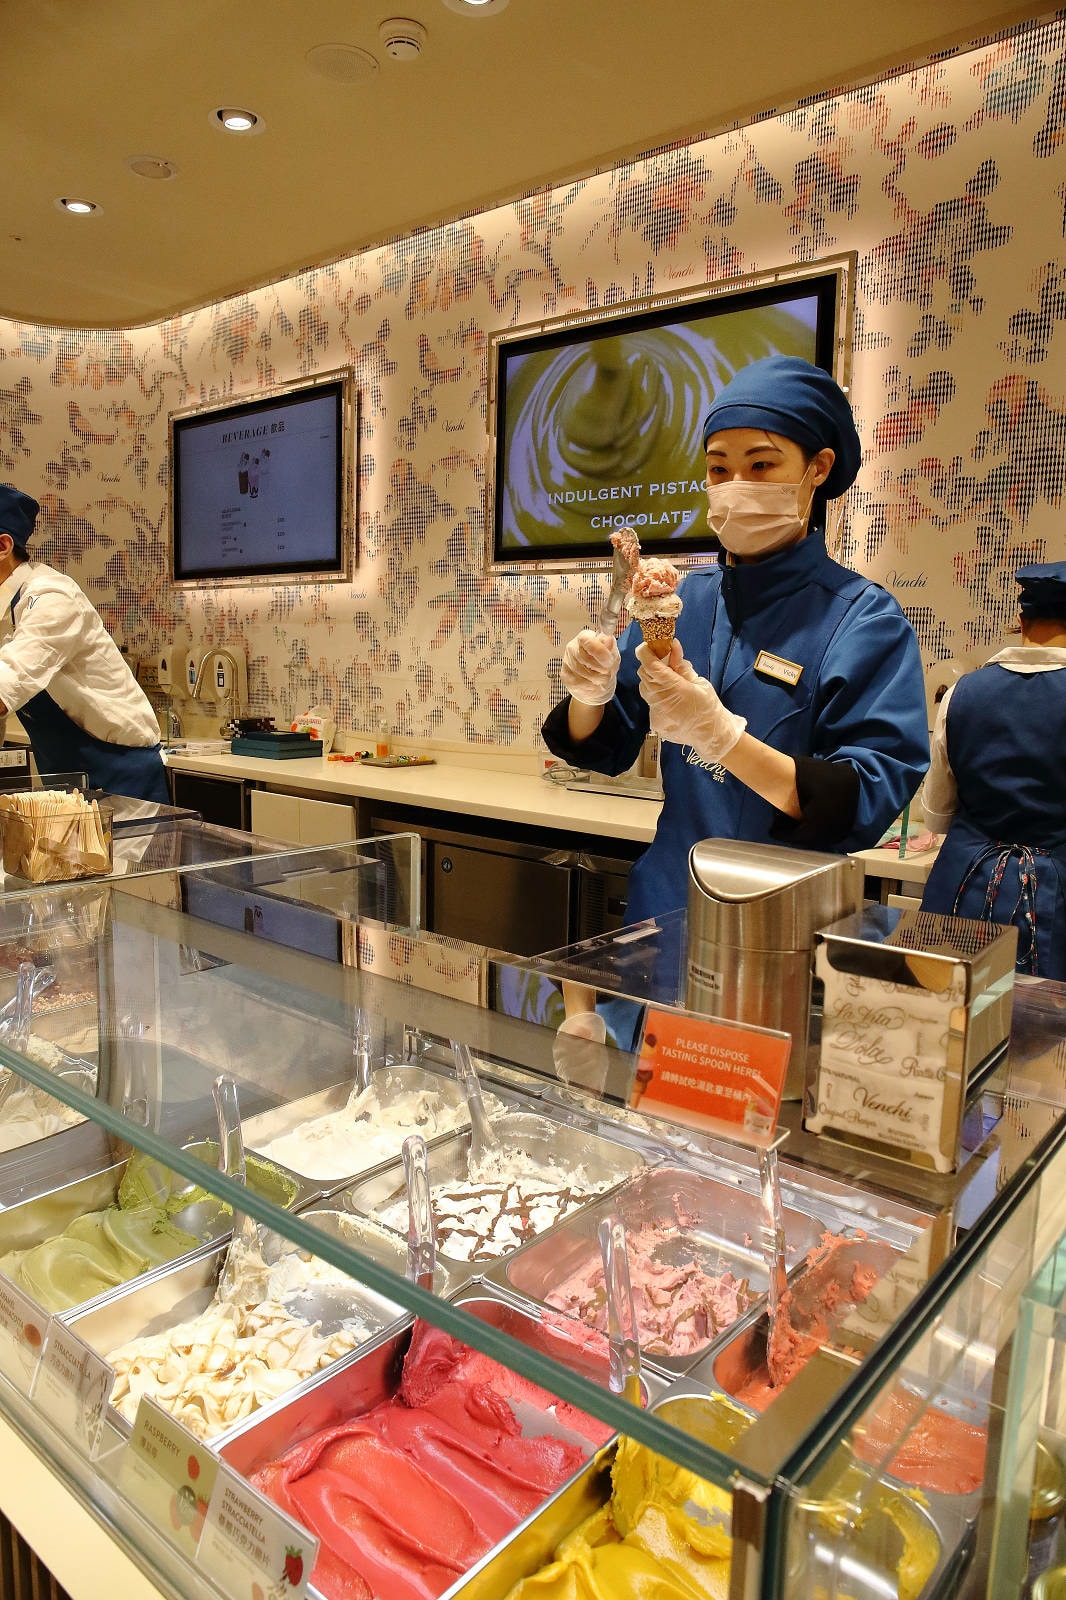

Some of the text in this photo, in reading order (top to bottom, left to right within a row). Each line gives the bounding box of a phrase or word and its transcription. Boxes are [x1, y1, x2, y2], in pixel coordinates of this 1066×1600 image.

[222, 424, 268, 443] BEVERAGE
[441, 417, 466, 433] Venchi
[548, 484, 643, 505] INDULGENT
[590, 509, 692, 529] CHOCOLATE
[885, 569, 928, 589] Venchi
[661, 1046, 697, 1065] TASTING
[699, 1055, 731, 1072] SPOON
[675, 1037, 750, 1064] PLEASE DISPOSE
[852, 1086, 914, 1118] Venchi
[143, 1419, 181, 1457] RASPBERRY
[224, 1487, 263, 1526] STRAWBERRY
[221, 1499, 266, 1544] STRACCIATELLA
